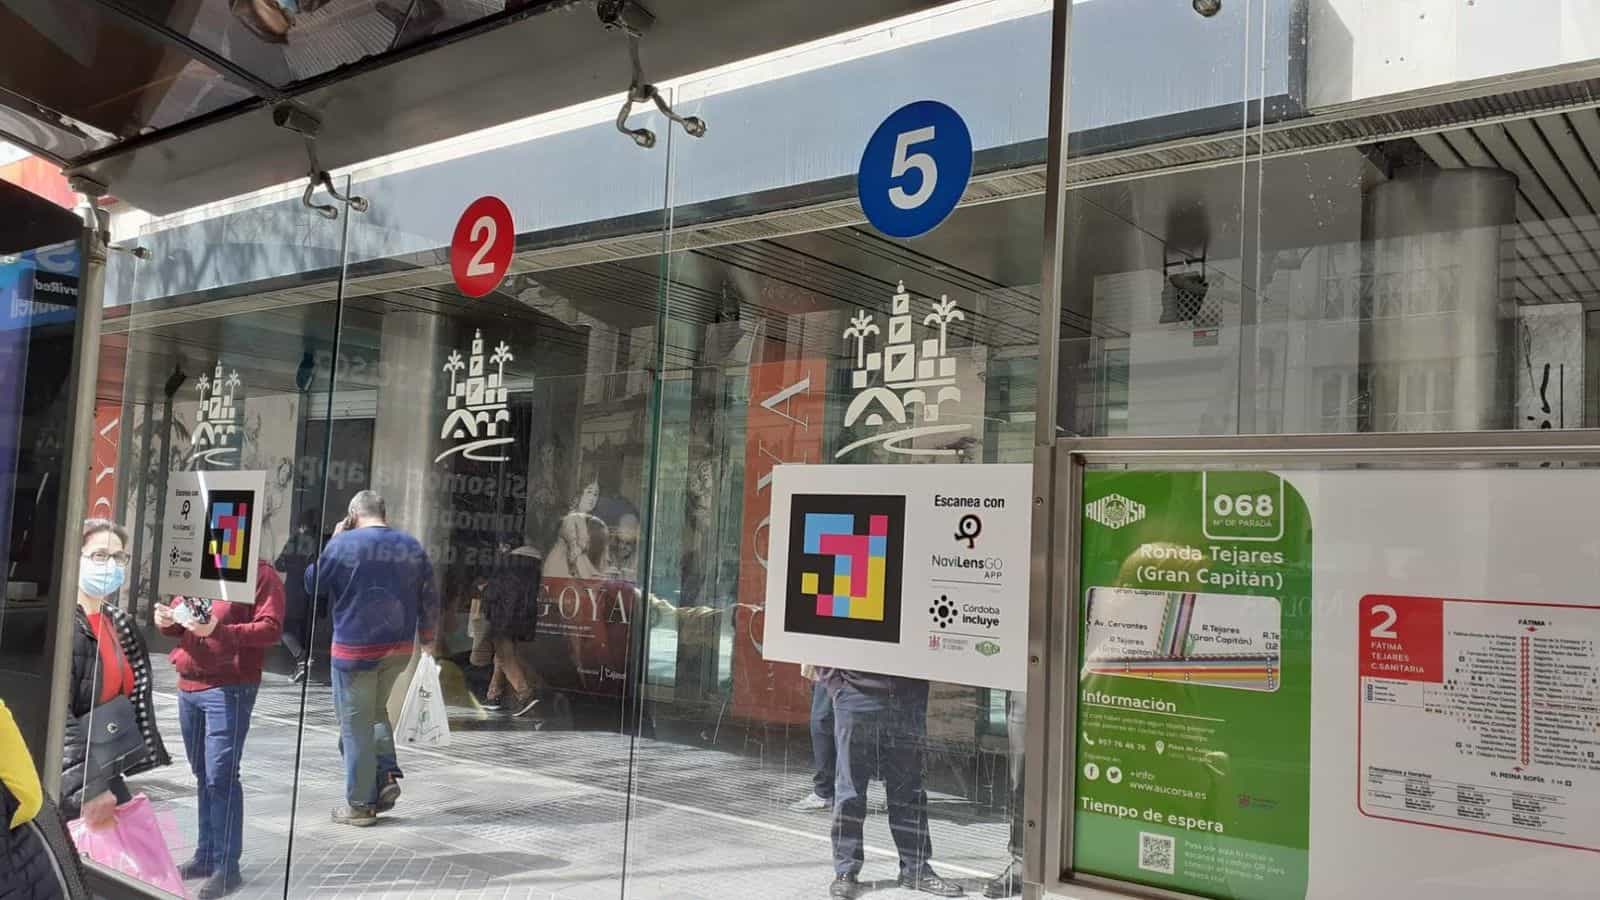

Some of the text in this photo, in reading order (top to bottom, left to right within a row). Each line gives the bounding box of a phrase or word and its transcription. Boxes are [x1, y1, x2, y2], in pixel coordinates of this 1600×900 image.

[887, 126, 939, 211] 5
[466, 215, 499, 278] 2
[934, 494, 1005, 508] Escanea con
[1214, 494, 1273, 517] 068
[932, 554, 1003, 569] NaviLensGO
[1141, 544, 1284, 566] Ronda Tejares
[984, 571, 1003, 580] APP
[1136, 566, 1284, 590] (Gran Capitán)
[962, 614, 1000, 629] incluye
[1108, 620, 1148, 631] Cervantes
[1370, 604, 1398, 639] 2
[1371, 640, 1402, 651] FÁTIMA
[1371, 652, 1410, 663] TEJARES
[1371, 663, 1424, 674] C.SANITARIA
[1081, 689, 1177, 713] Información
[1129, 782, 1207, 800] www.aucorsa.es
[1080, 796, 1224, 833] Tiempo de espera
